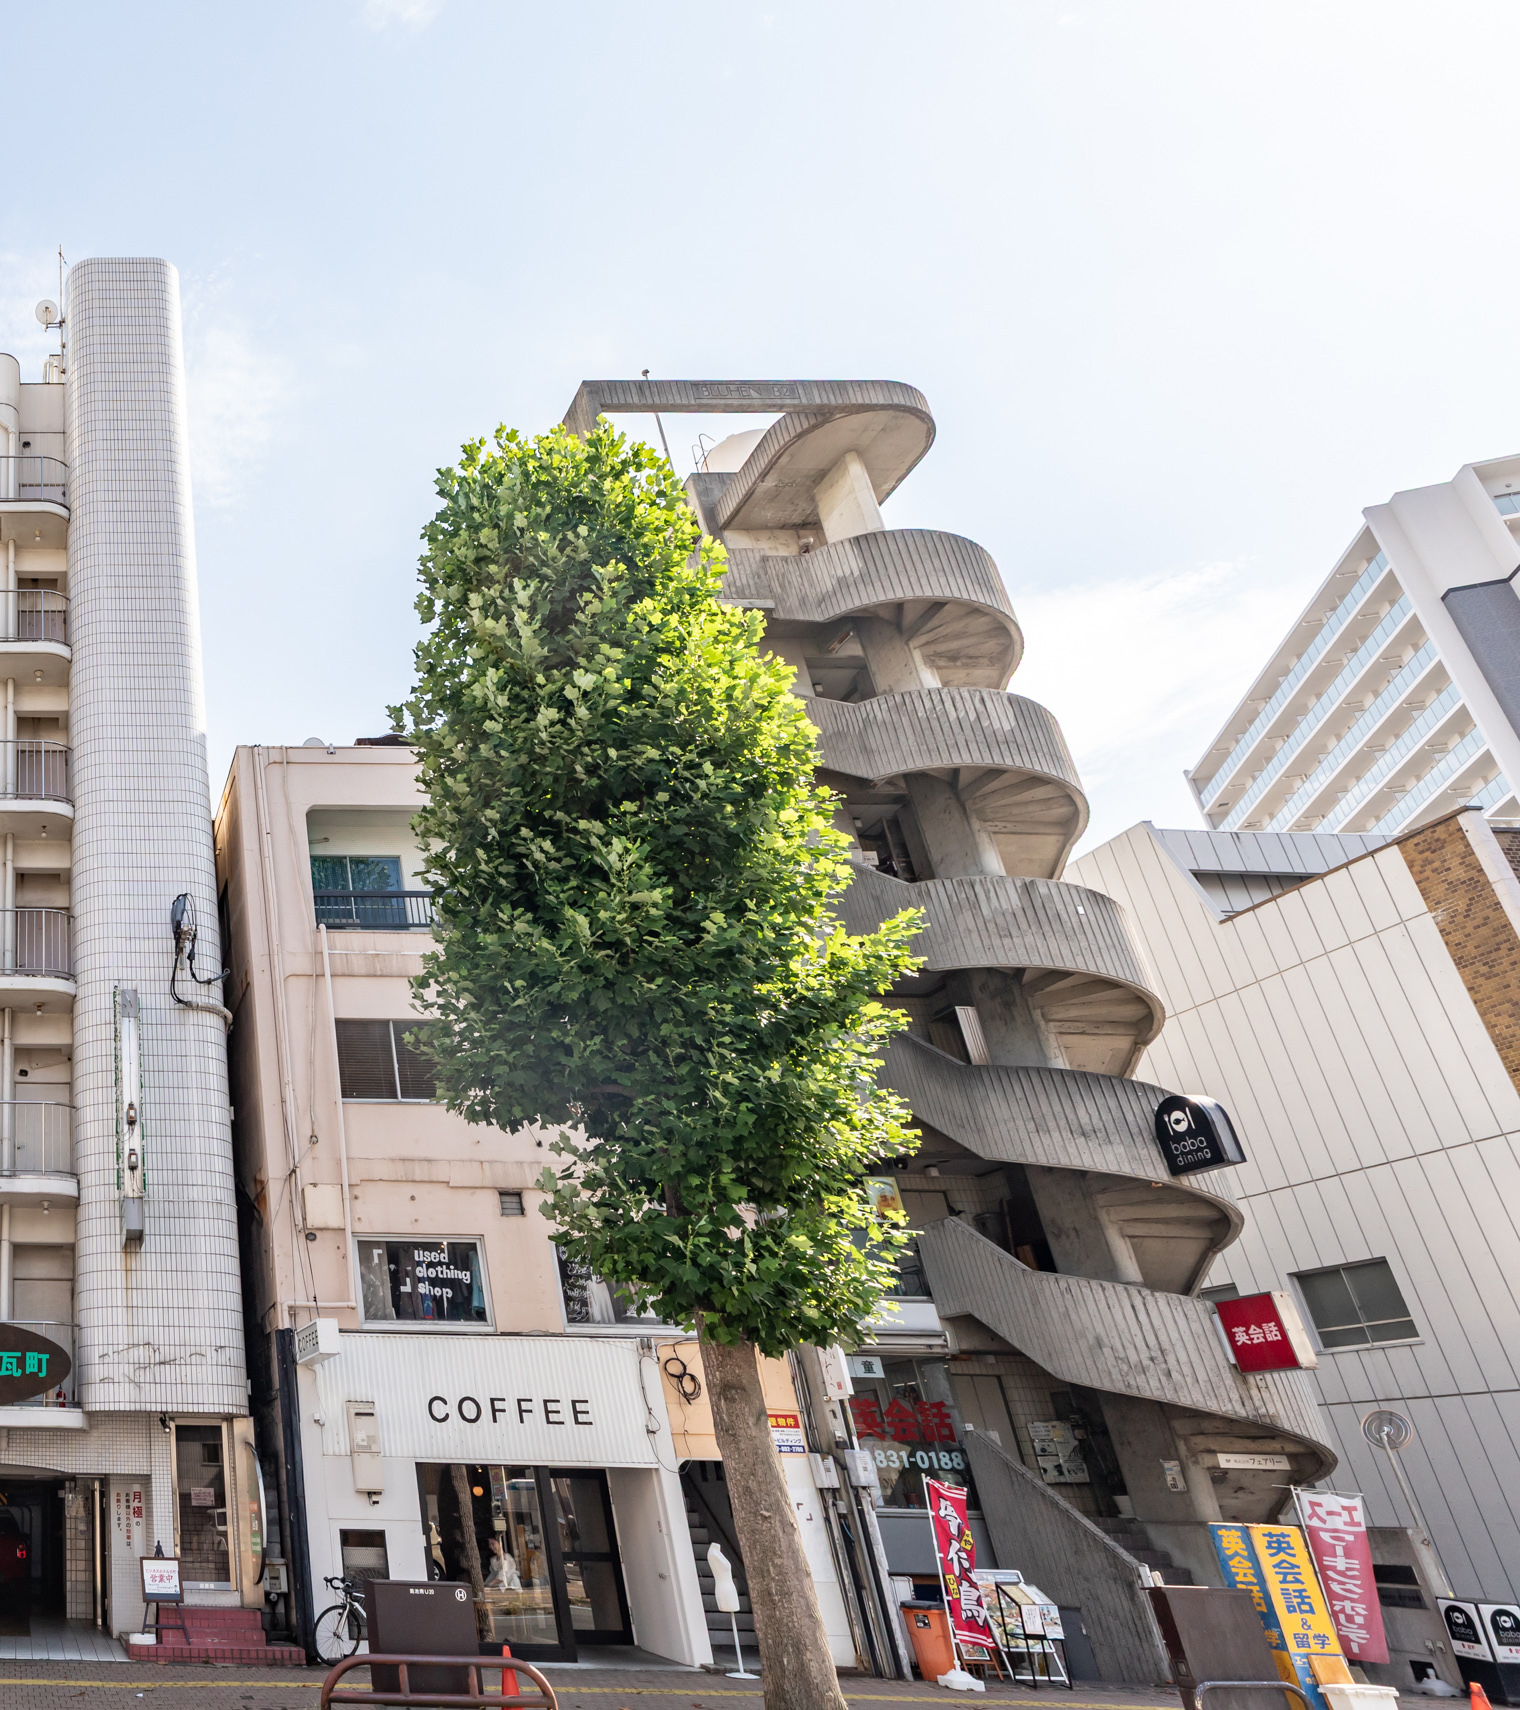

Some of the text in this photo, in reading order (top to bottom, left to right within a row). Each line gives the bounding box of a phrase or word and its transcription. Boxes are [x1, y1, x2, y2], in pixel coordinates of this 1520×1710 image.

[1170, 1136, 1207, 1154] baba
[1177, 1149, 1211, 1166] dining
[414, 1244, 449, 1262] used
[416, 1264, 471, 1283] clothing
[418, 1281, 454, 1308] shop
[297, 1329, 320, 1353] COFFEE
[1232, 1322, 1282, 1346] 英会話
[428, 1395, 593, 1426] COFFEE
[849, 1398, 957, 1443] 英会話
[874, 1450, 965, 1470] 831-0188
[150, 1573, 173, 1584] 営業中
[1262, 1531, 1316, 1615] 英会話
[1300, 1617, 1313, 1631] &
[1293, 1632, 1331, 1649] 留学
